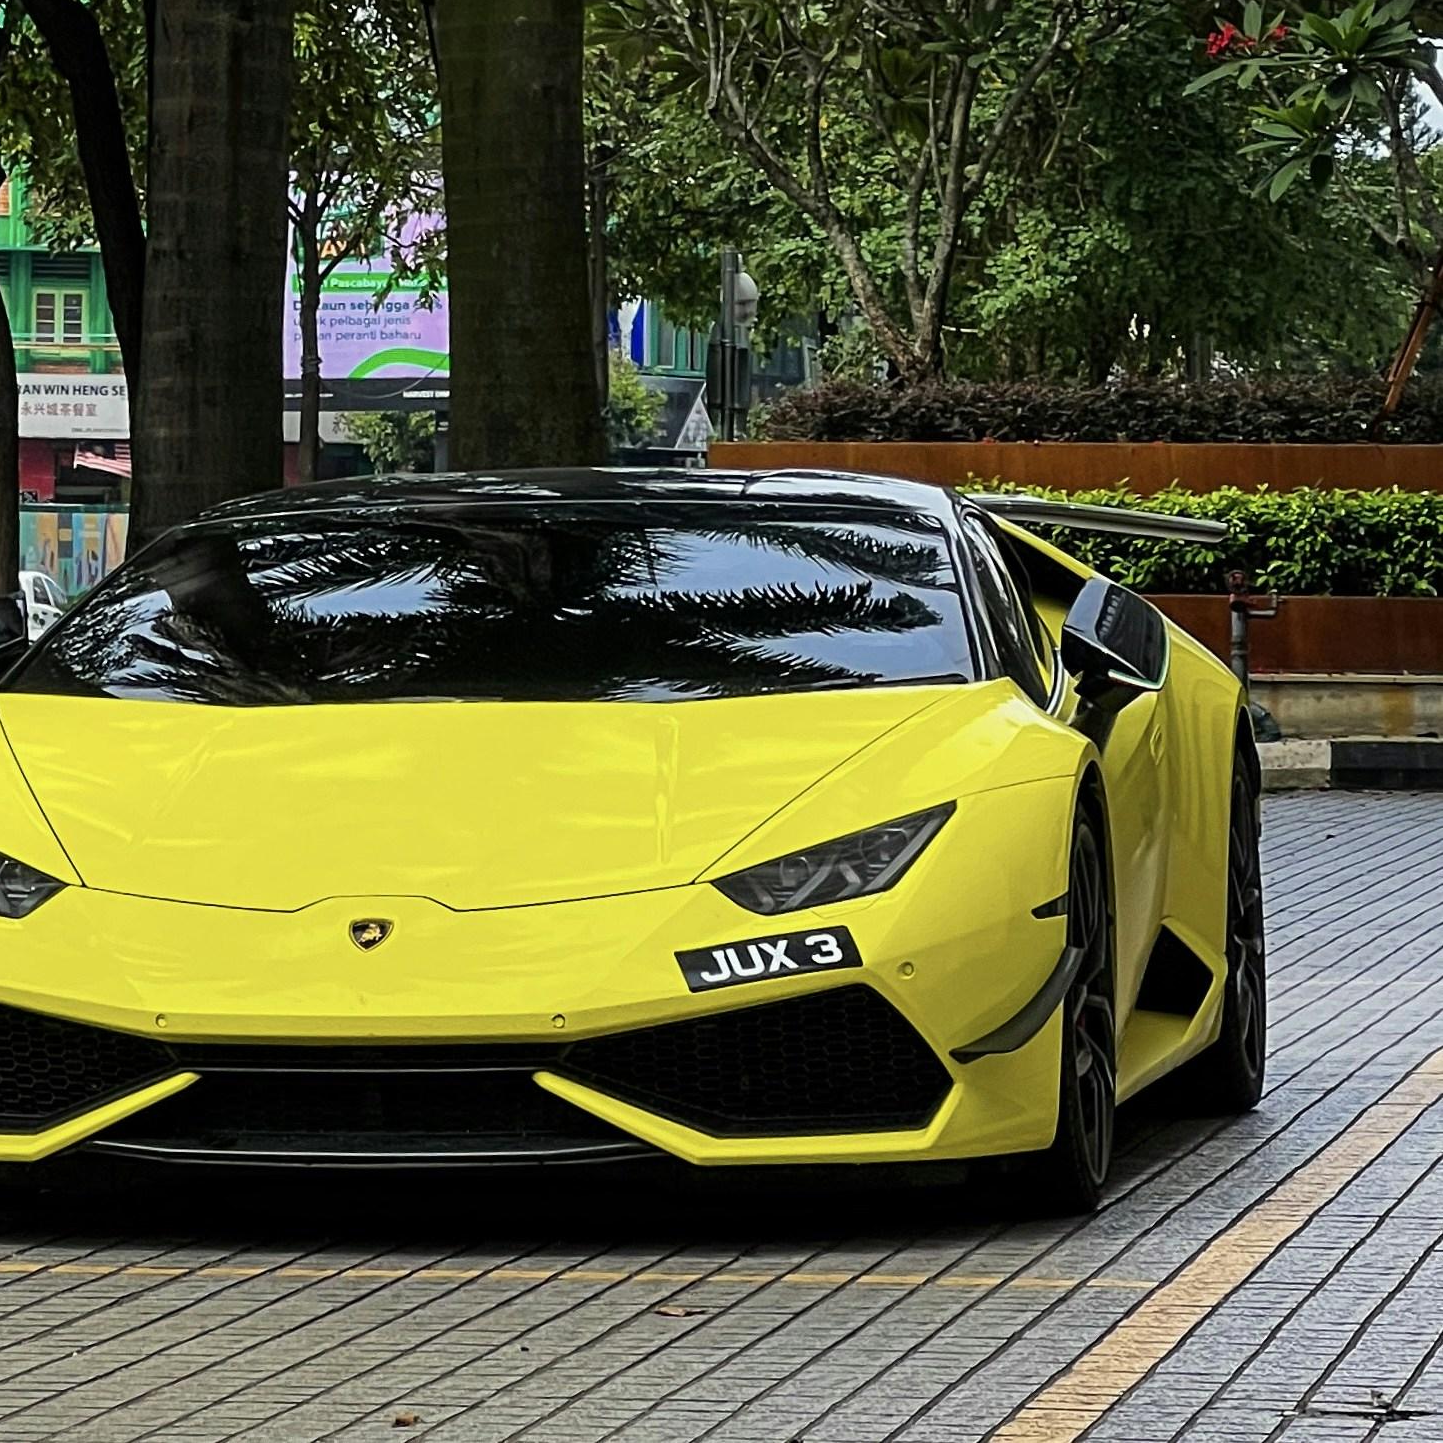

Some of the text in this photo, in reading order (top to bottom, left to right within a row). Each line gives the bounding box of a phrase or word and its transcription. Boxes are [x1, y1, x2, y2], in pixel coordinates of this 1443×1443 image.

[330, 314, 381, 327] pelbagai
[384, 314, 411, 328] jenis
[336, 329, 377, 343] peranti
[380, 329, 422, 341] baharu
[45, 384, 69, 396] WIN
[72, 385, 108, 396] HENG
[700, 933, 843, 983] JUX 3
